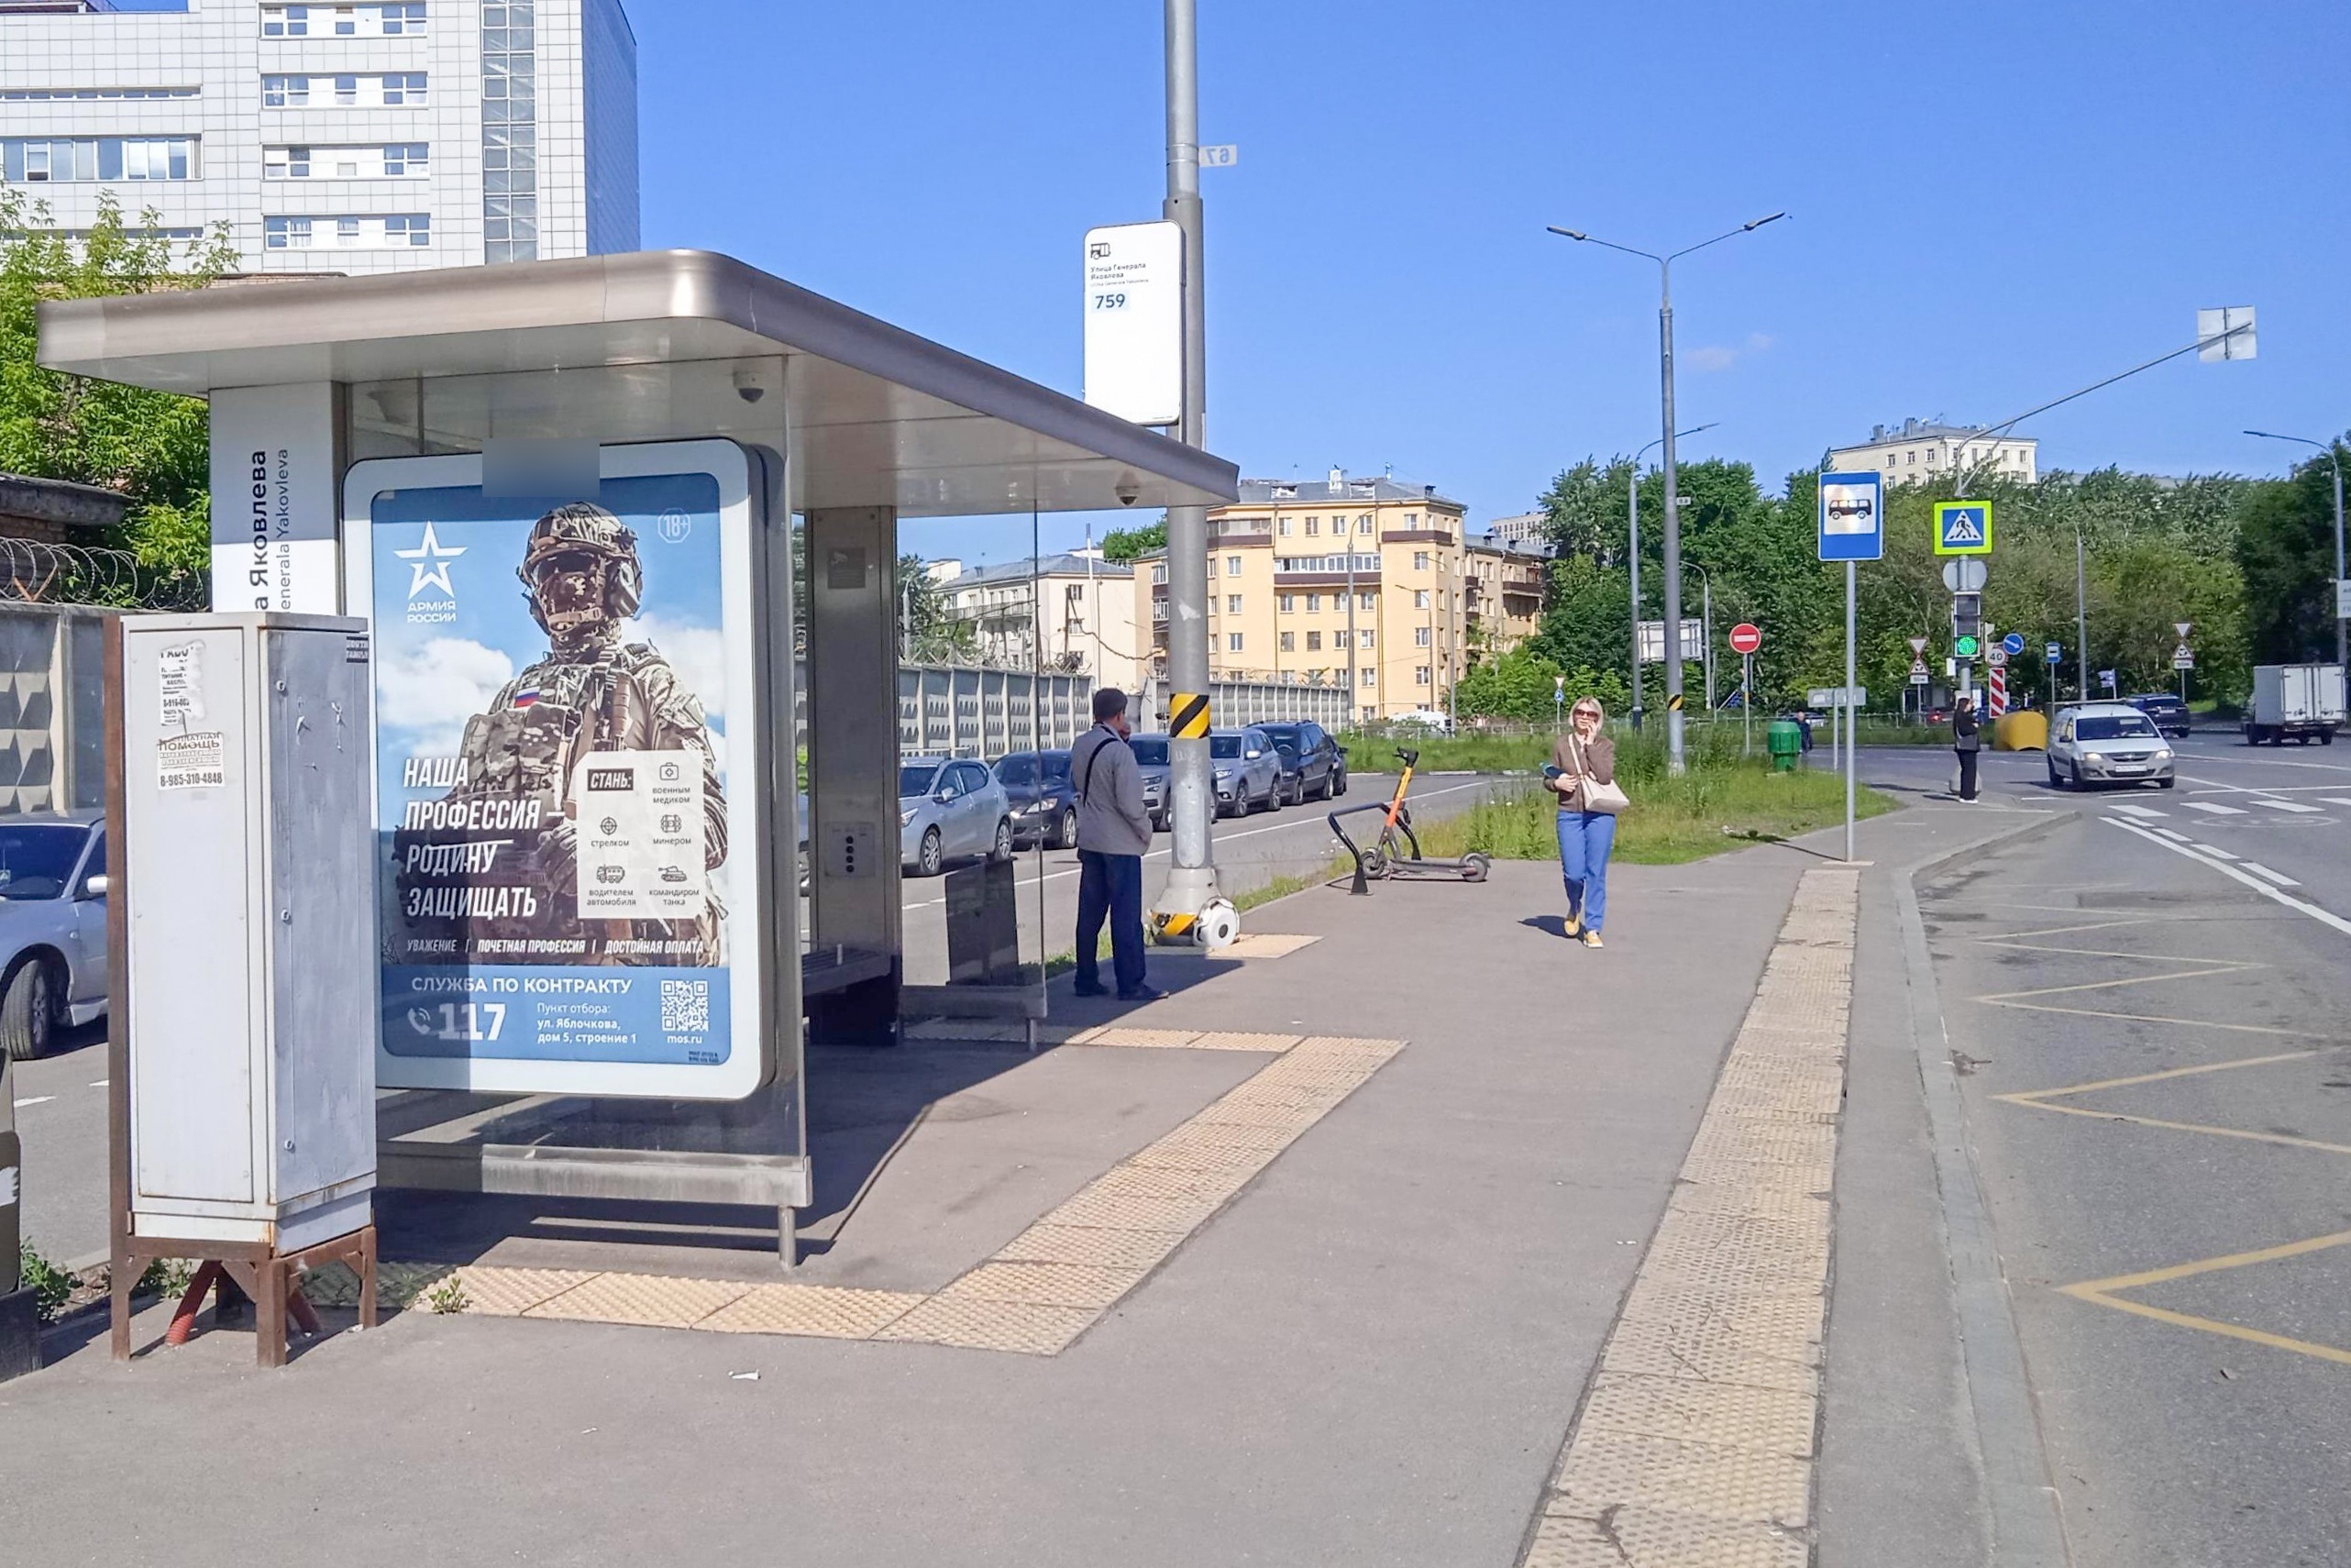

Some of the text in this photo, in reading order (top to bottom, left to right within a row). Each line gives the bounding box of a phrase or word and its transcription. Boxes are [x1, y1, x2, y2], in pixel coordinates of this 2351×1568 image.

[1095, 293, 1126, 309] 759
[249, 450, 269, 587] Яковлева
[663, 514, 689, 537] 18+
[275, 448, 292, 611] enerala Yakovleva
[407, 601, 457, 613] АРМИЯ
[407, 613, 457, 624] РОССИИ
[1990, 652, 2003, 661] 40
[159, 739, 220, 751] ПОМОЩЬ
[160, 772, 223, 788] 8-985-310-4848
[403, 757, 469, 788] НАША
[591, 771, 632, 790] СТАНЬ:
[653, 796, 690, 804] медиком
[404, 800, 542, 831] ПРОФЕССИЯ
[591, 839, 630, 849] стрелком
[653, 837, 691, 846] минером
[406, 843, 499, 877] РОДИНУ
[589, 889, 634, 898] водителем
[649, 888, 700, 898] командиром
[407, 887, 537, 921] ЗАЩИЩАТЬ
[587, 898, 636, 907] автомобиля
[407, 937, 704, 955] УВАЖЕНИЕ ПОЧЕТНАЯ ПРОФЕССИЯ ДОСТОЙНАЯ ОПЛАТА
[412, 977, 633, 994] СЛУЖБА ПО КОНТРАКТУ
[537, 1001, 611, 1016] Пункт отбора:
[438, 1002, 506, 1041] 117
[537, 1017, 622, 1032] ул. Яблочкова,
[537, 1032, 637, 1045] дом 5, строение 1
[667, 1034, 703, 1044] mos.ru
